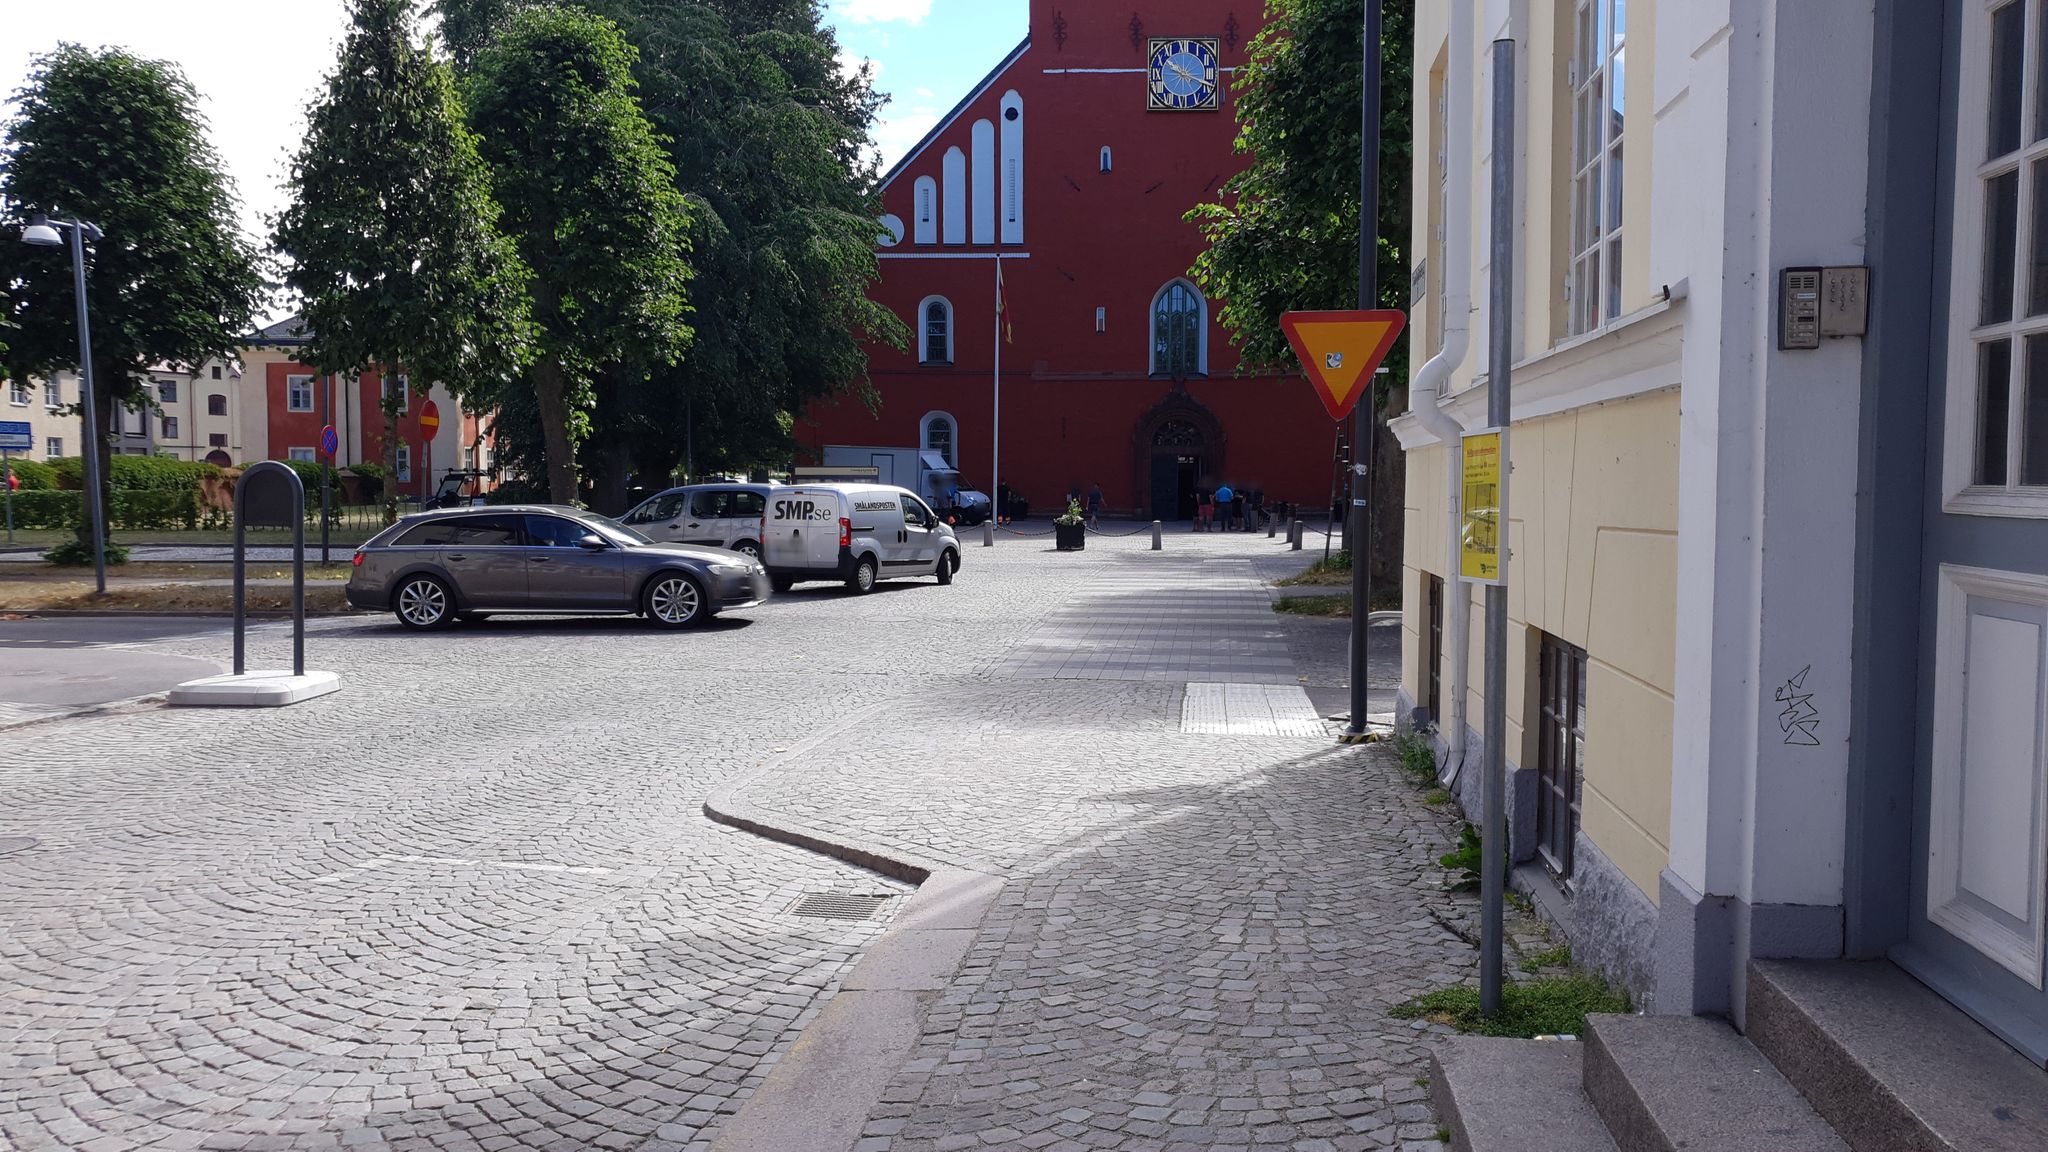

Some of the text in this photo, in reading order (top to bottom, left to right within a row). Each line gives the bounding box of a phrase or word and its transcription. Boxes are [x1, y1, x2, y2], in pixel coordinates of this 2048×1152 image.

[1152, 68, 1161, 80] IX
[1206, 68, 1214, 80] III
[774, 500, 832, 521] SMP.se
[854, 500, 897, 510] SMÅLANDSPOSTEN
